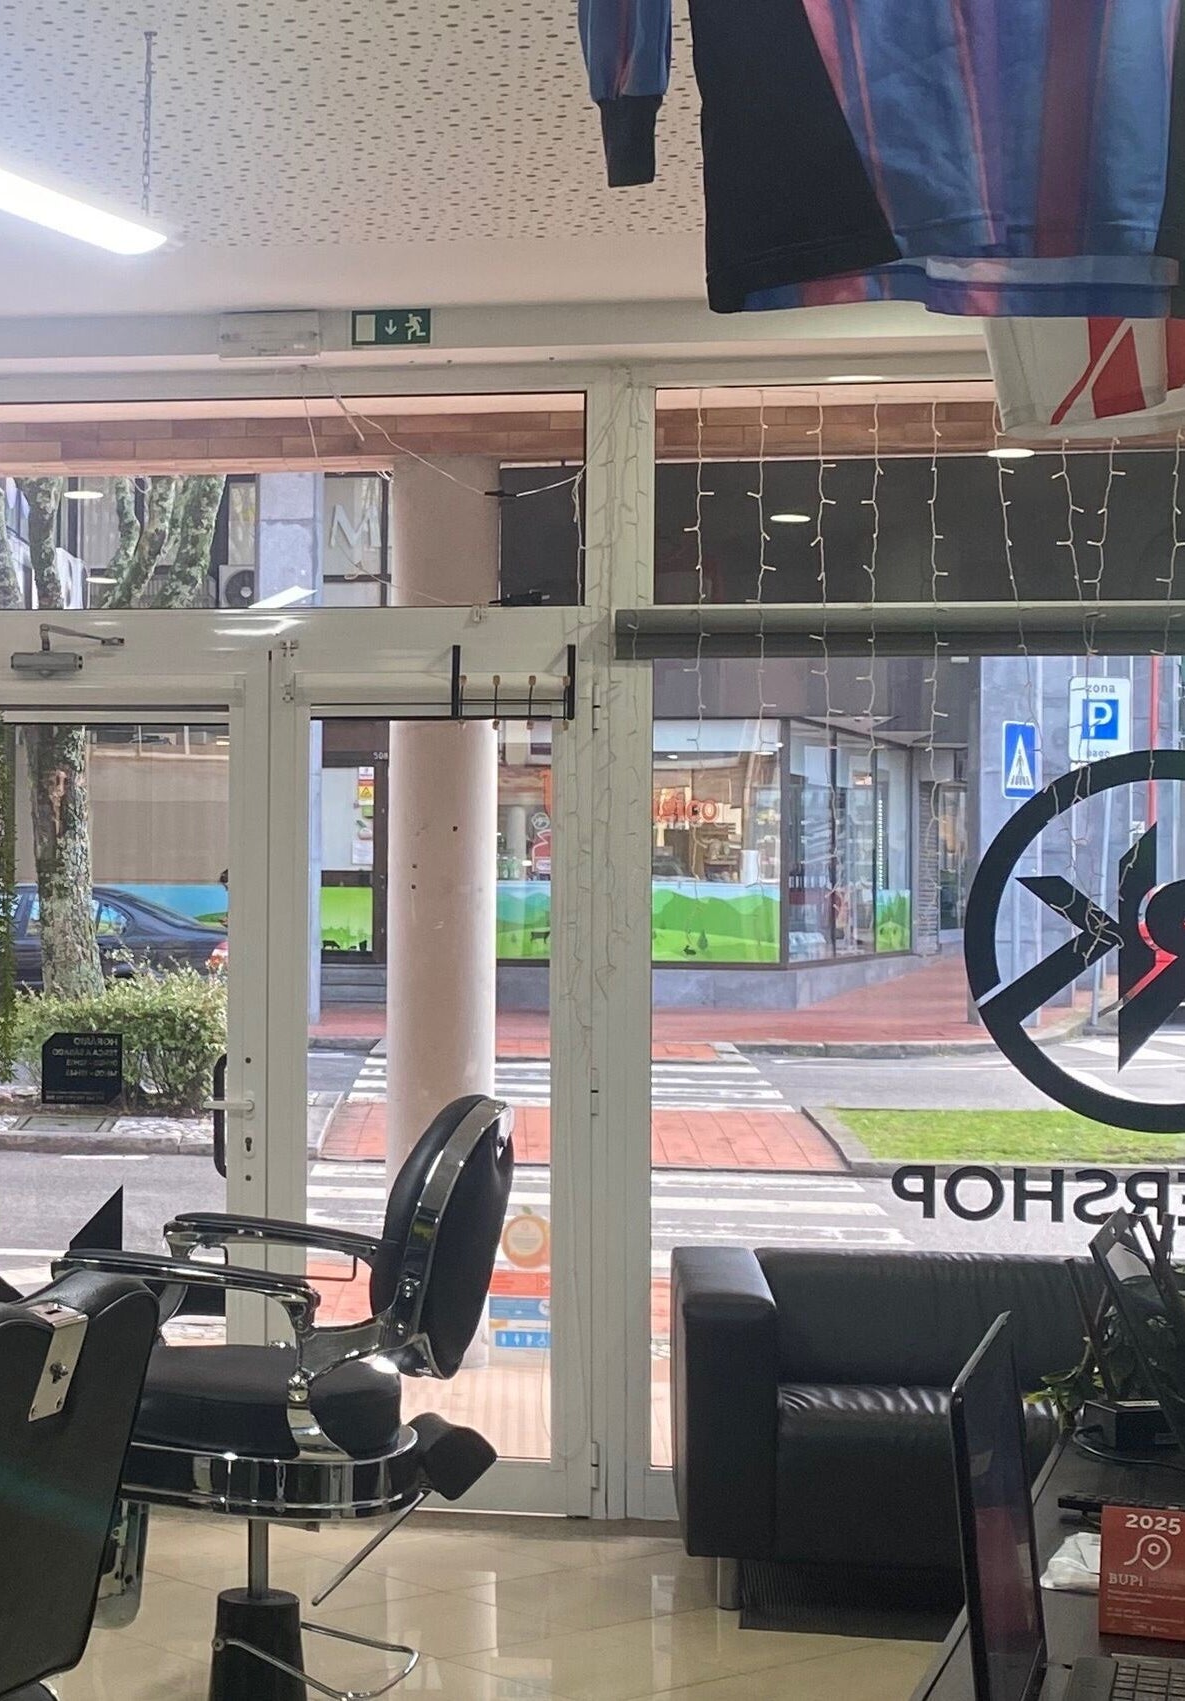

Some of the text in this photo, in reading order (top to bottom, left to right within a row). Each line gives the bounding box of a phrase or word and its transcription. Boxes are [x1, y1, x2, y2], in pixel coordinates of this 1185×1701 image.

[1086, 684, 1116, 694] zona
[1088, 701, 1113, 738] P
[1124, 1513, 1182, 1536] 2025
